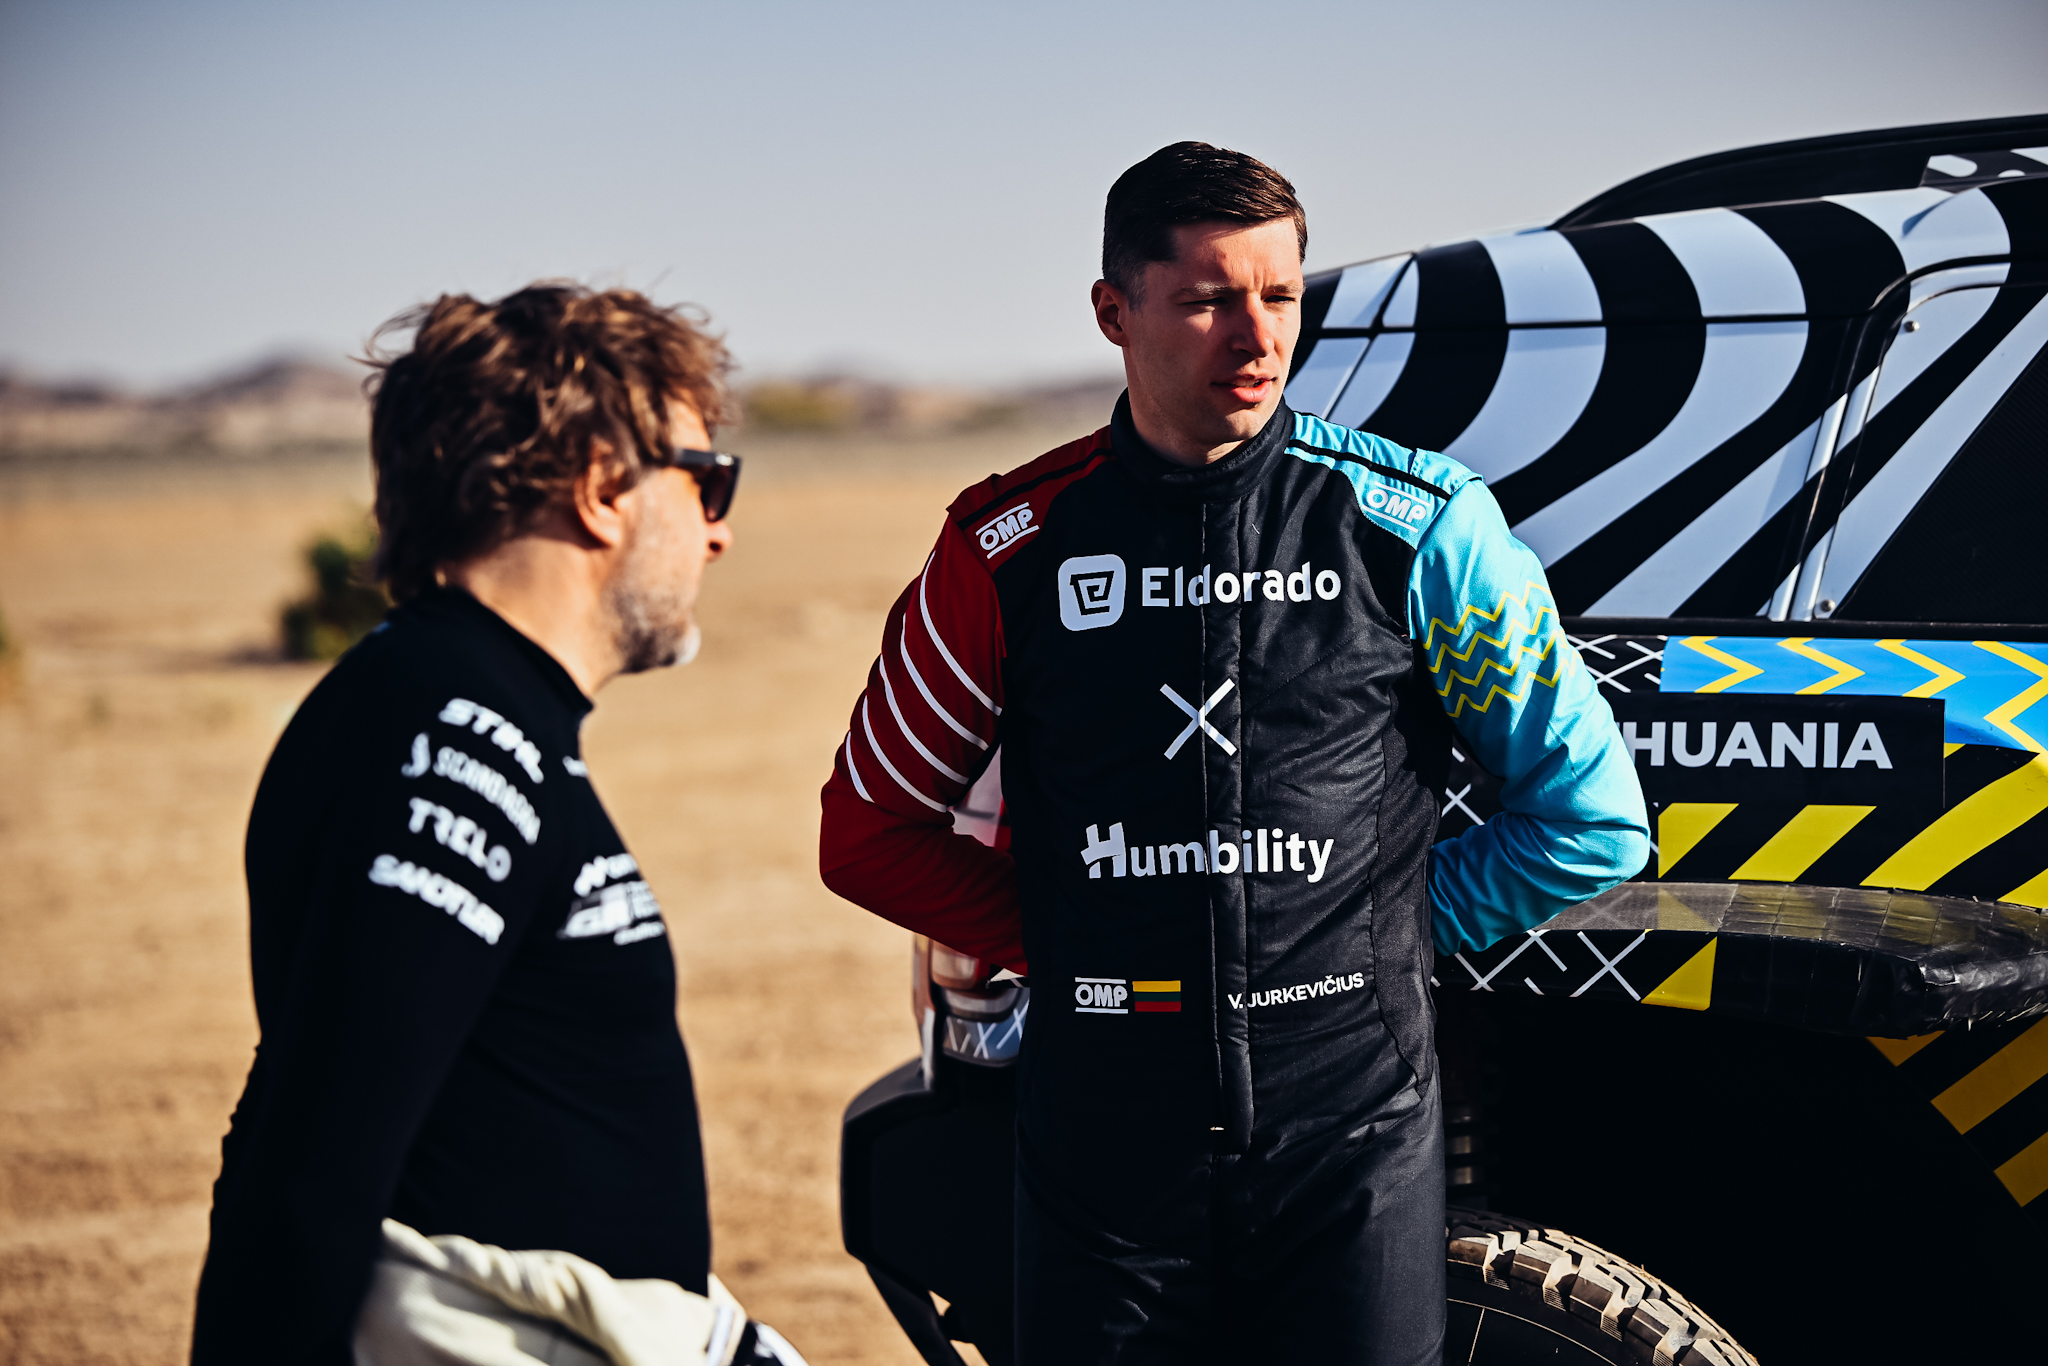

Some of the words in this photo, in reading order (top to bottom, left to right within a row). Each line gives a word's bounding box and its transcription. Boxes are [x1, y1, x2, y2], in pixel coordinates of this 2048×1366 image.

[1366, 488, 1427, 523] OMP
[980, 508, 1034, 551] OMP
[1142, 561, 1342, 607] Eldorado
[1616, 721, 1893, 769] HUANIA
[1080, 822, 1335, 883] Humbility
[1075, 983, 1128, 1008] OMP
[1227, 992, 1244, 1010] V.
[1247, 971, 1365, 1009] JURKEVIČIUS
